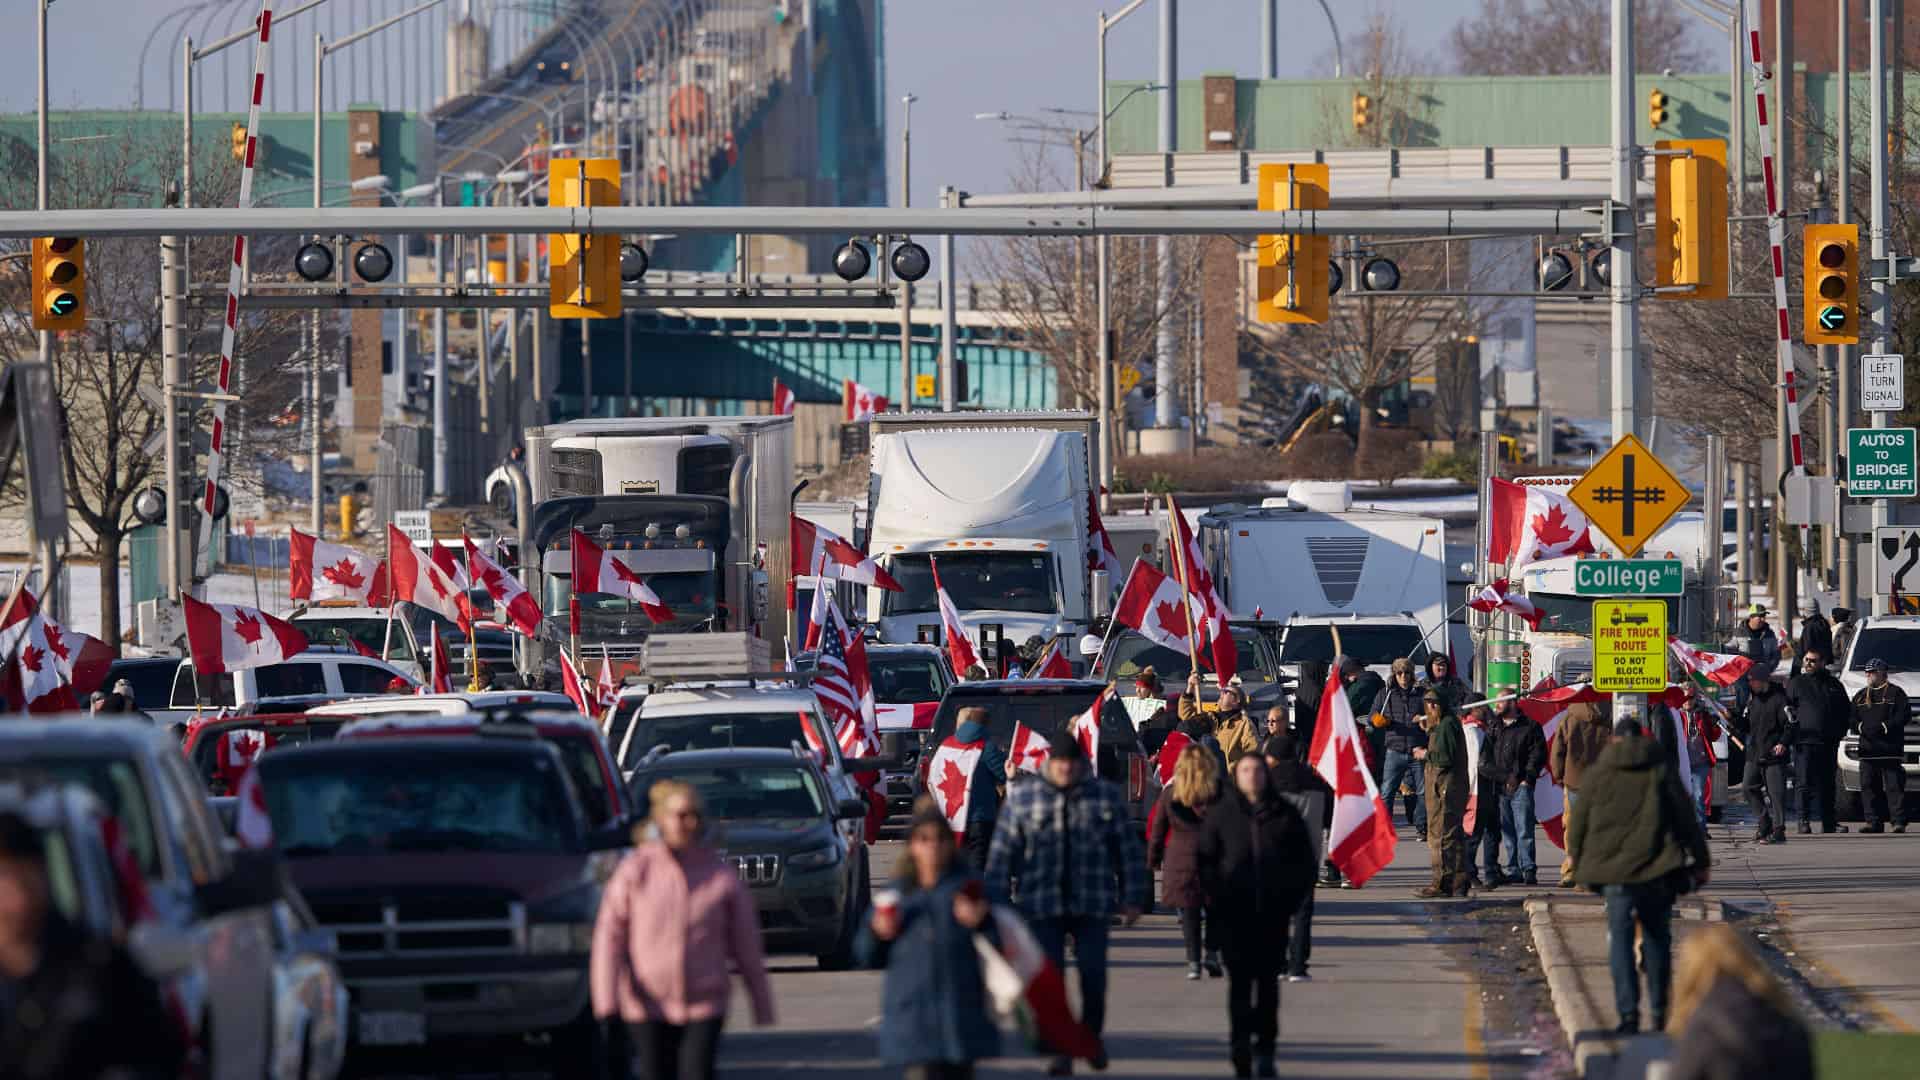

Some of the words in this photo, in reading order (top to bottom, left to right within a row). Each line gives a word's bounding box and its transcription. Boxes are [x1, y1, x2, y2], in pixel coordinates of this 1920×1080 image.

[1870, 362, 1894, 373] LEFT
[1870, 376, 1895, 387] TURN
[1865, 391, 1899, 401] SIGNAL
[1859, 434, 1905, 447] AUTOS
[1874, 450, 1889, 459] TO
[1856, 464, 1908, 476] BRIDGE
[1850, 480, 1881, 490] KEEP
[1886, 480, 1914, 490] LEFT
[1577, 565, 1661, 592] College
[1664, 565, 1680, 576] Ave.
[1600, 628, 1622, 638] FIRE
[1627, 628, 1661, 638] TRUCK
[1614, 641, 1647, 651] ROUTE
[1614, 657, 1626, 665] DO
[1630, 657, 1646, 665] NOT
[1616, 667, 1644, 675] BLOCK
[1600, 677, 1661, 686] INTERSECTION
